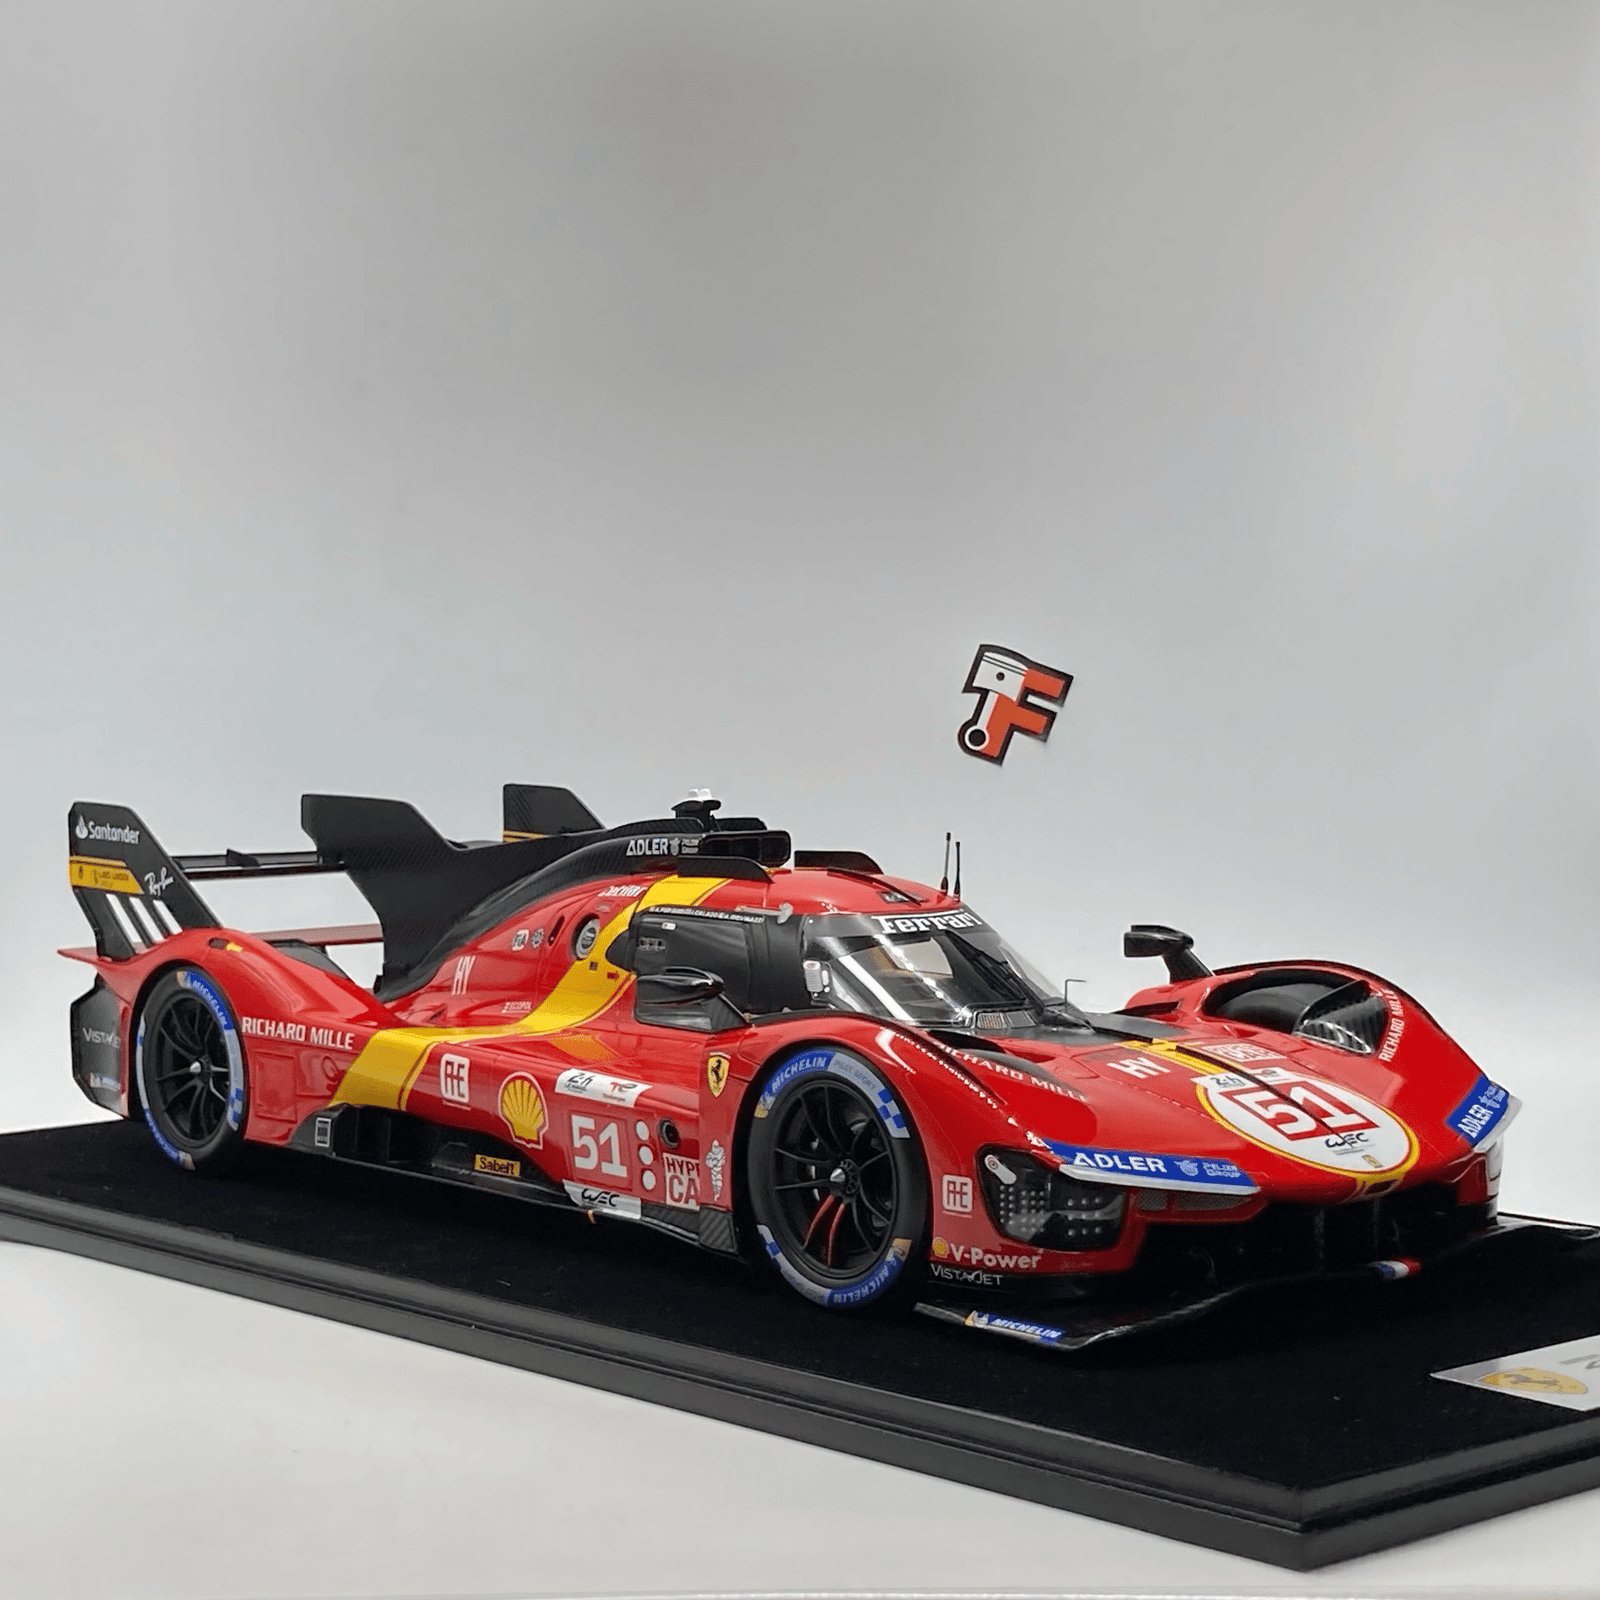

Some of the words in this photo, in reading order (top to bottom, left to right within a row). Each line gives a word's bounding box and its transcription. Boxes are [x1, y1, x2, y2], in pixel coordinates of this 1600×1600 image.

[88, 820, 140, 845] Santander
[625, 838, 669, 857] ADLER
[871, 908, 983, 934] Ferrari
[241, 1016, 307, 1042] RICHARD
[310, 1026, 356, 1050] MILLE
[1378, 1016, 1406, 1063] RICHARD
[771, 1056, 828, 1092] MICHELIN
[1106, 1056, 1171, 1079] HY
[1232, 1085, 1369, 1136] 51
[1457, 1104, 1494, 1139] ADLER
[570, 1113, 628, 1178] 51
[1325, 1132, 1370, 1149] WEC
[1073, 1152, 1168, 1173] ADLER
[580, 1187, 621, 1208] WEC
[950, 1243, 1042, 1269] V-Power
[833, 1264, 890, 1304] MICHELIN
[990, 1317, 1063, 1339] MICHELIN
